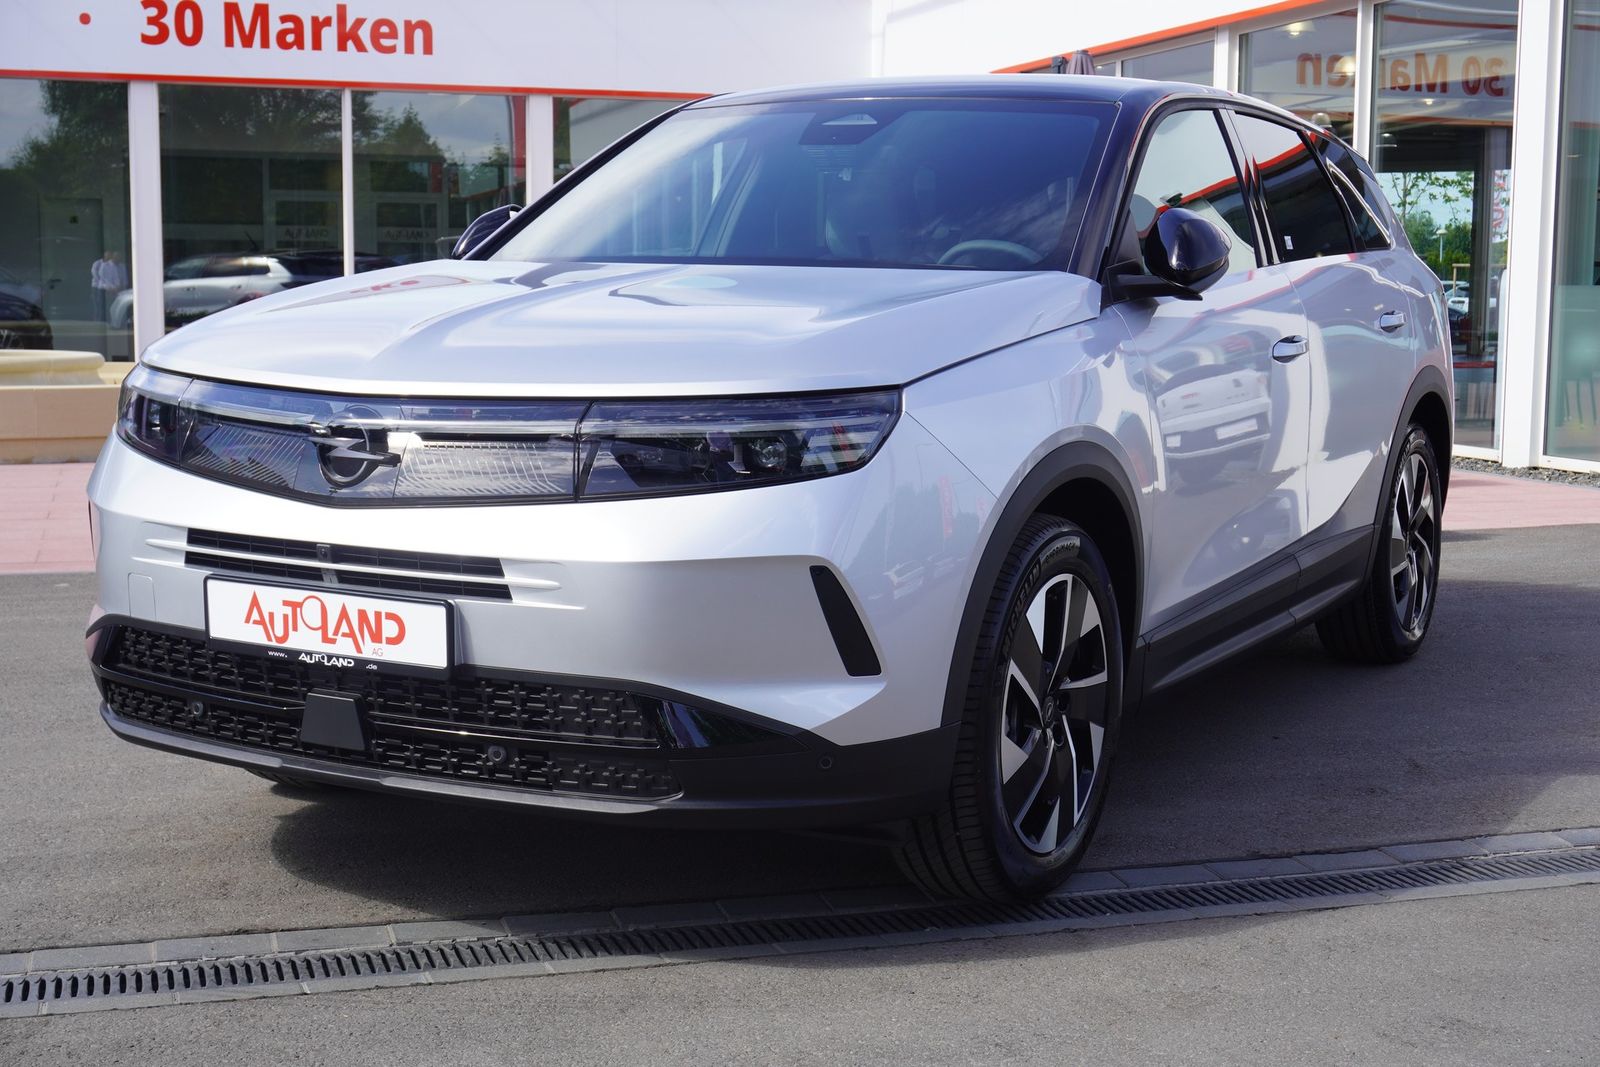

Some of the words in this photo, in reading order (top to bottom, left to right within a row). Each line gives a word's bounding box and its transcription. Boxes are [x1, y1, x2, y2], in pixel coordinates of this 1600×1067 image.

[140, 0, 203, 46] 30
[223, 2, 434, 55] Marken
[244, 590, 406, 654] AUTOLAND
[267, 650, 288, 658] www.
[299, 652, 354, 668] AUTOLAND
[372, 647, 383, 657] AG
